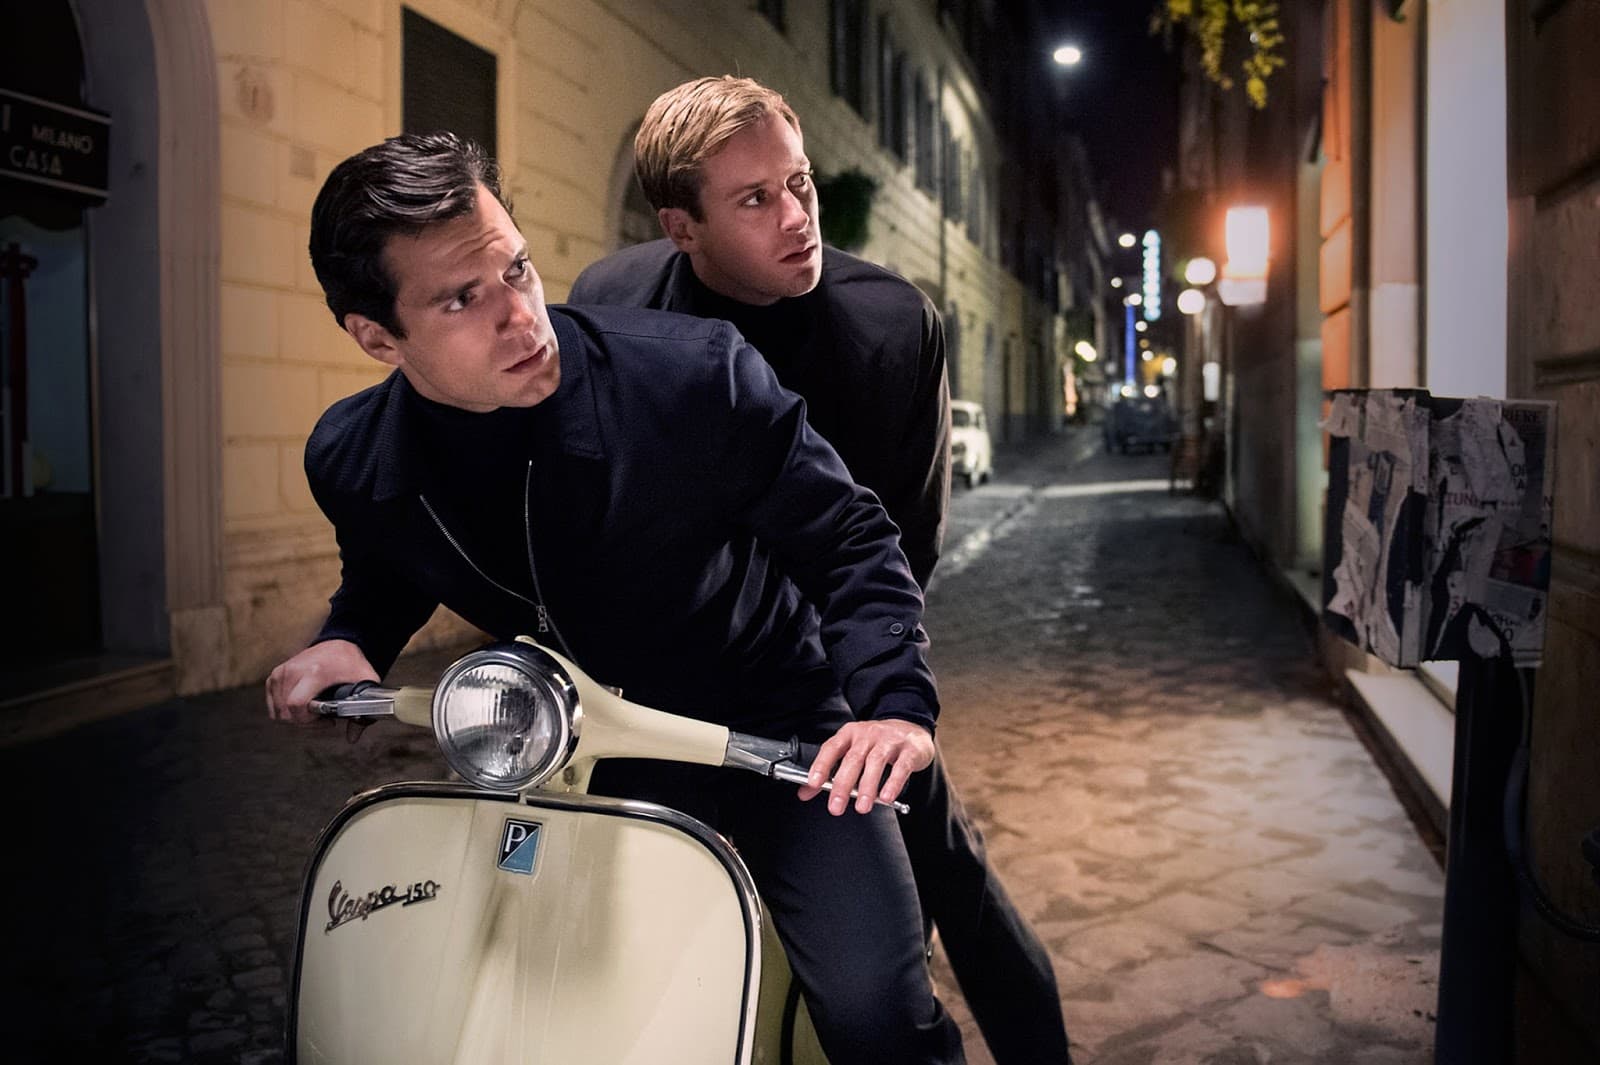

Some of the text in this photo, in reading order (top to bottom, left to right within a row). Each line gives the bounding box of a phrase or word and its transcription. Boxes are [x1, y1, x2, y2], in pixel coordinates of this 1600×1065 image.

[31, 123, 95, 155] MILANO
[9, 145, 63, 176] CASA
[505, 824, 527, 853] P
[324, 880, 441, 935] Vespa 150
